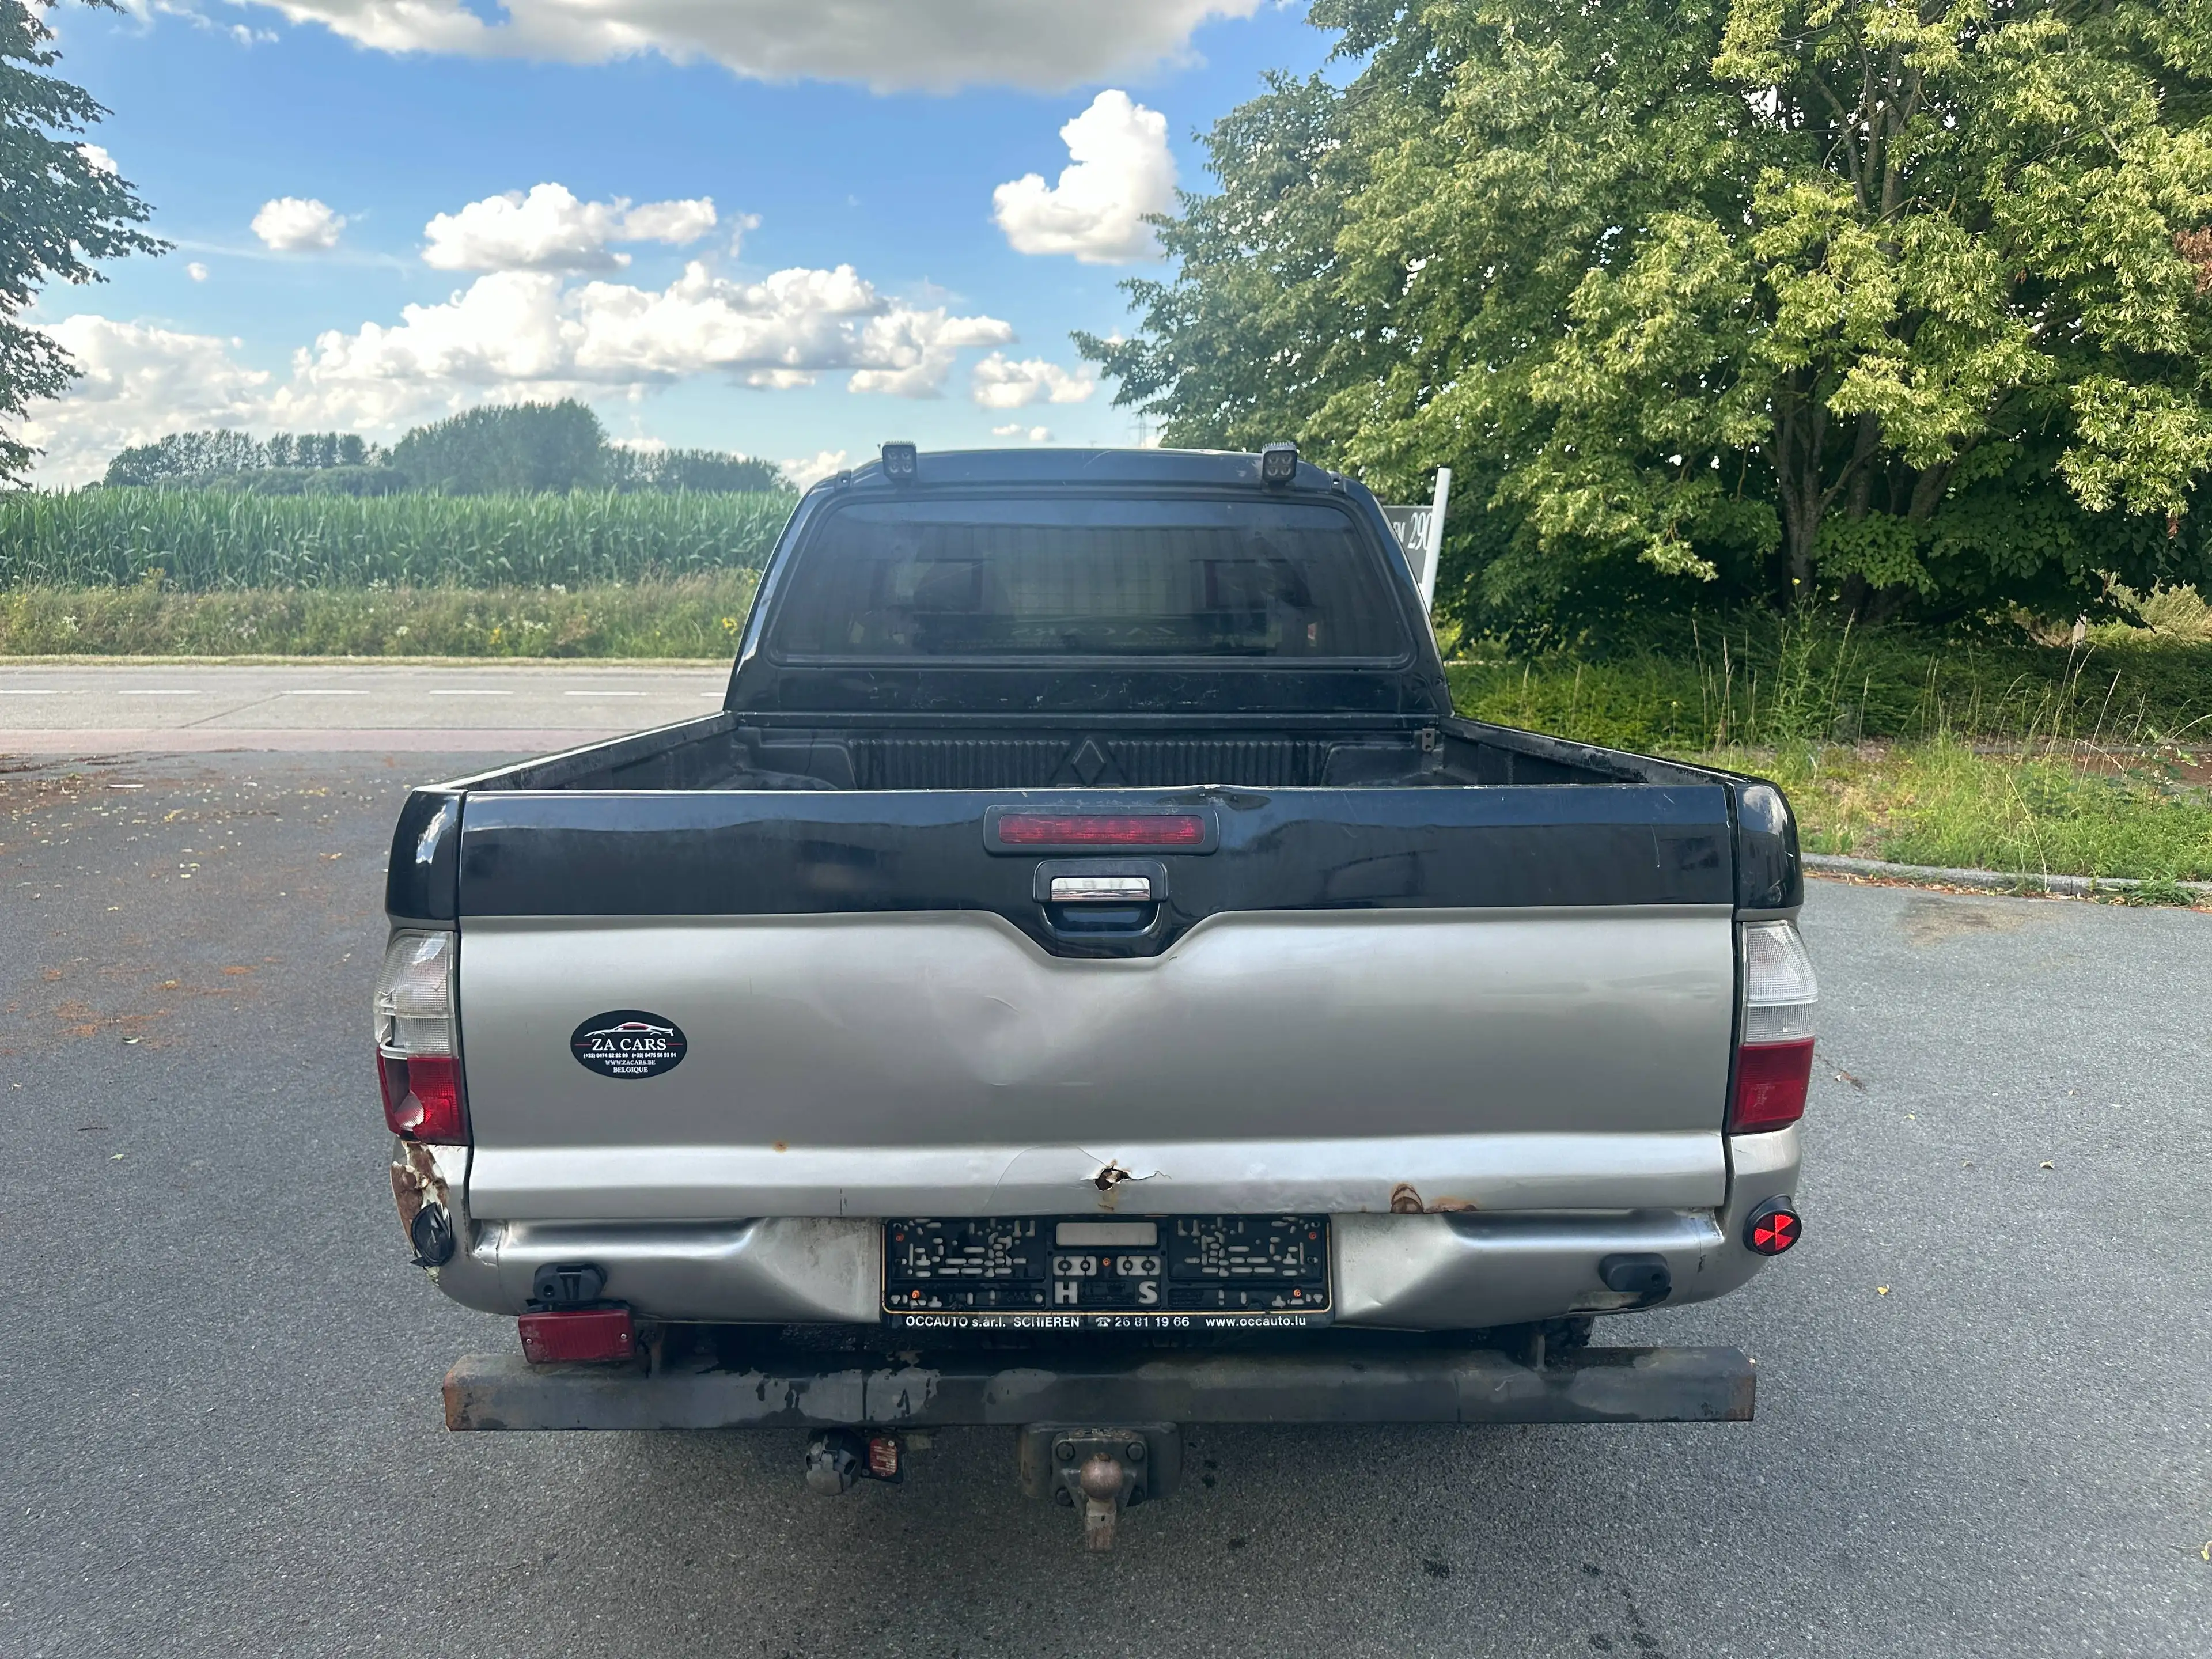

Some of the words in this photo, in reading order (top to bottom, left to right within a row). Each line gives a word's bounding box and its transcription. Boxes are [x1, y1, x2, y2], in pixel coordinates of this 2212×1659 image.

[592, 1039, 616, 1051] ZA
[620, 1038, 666, 1051] CARS
[906, 1316, 968, 1327] OCCAUTO
[1115, 1316, 1130, 1327] 26
[1134, 1316, 1149, 1327] 81
[1155, 1316, 1169, 1327] 19
[1173, 1316, 1190, 1327] 66
[1206, 1316, 1306, 1327] www.occauto.lu
